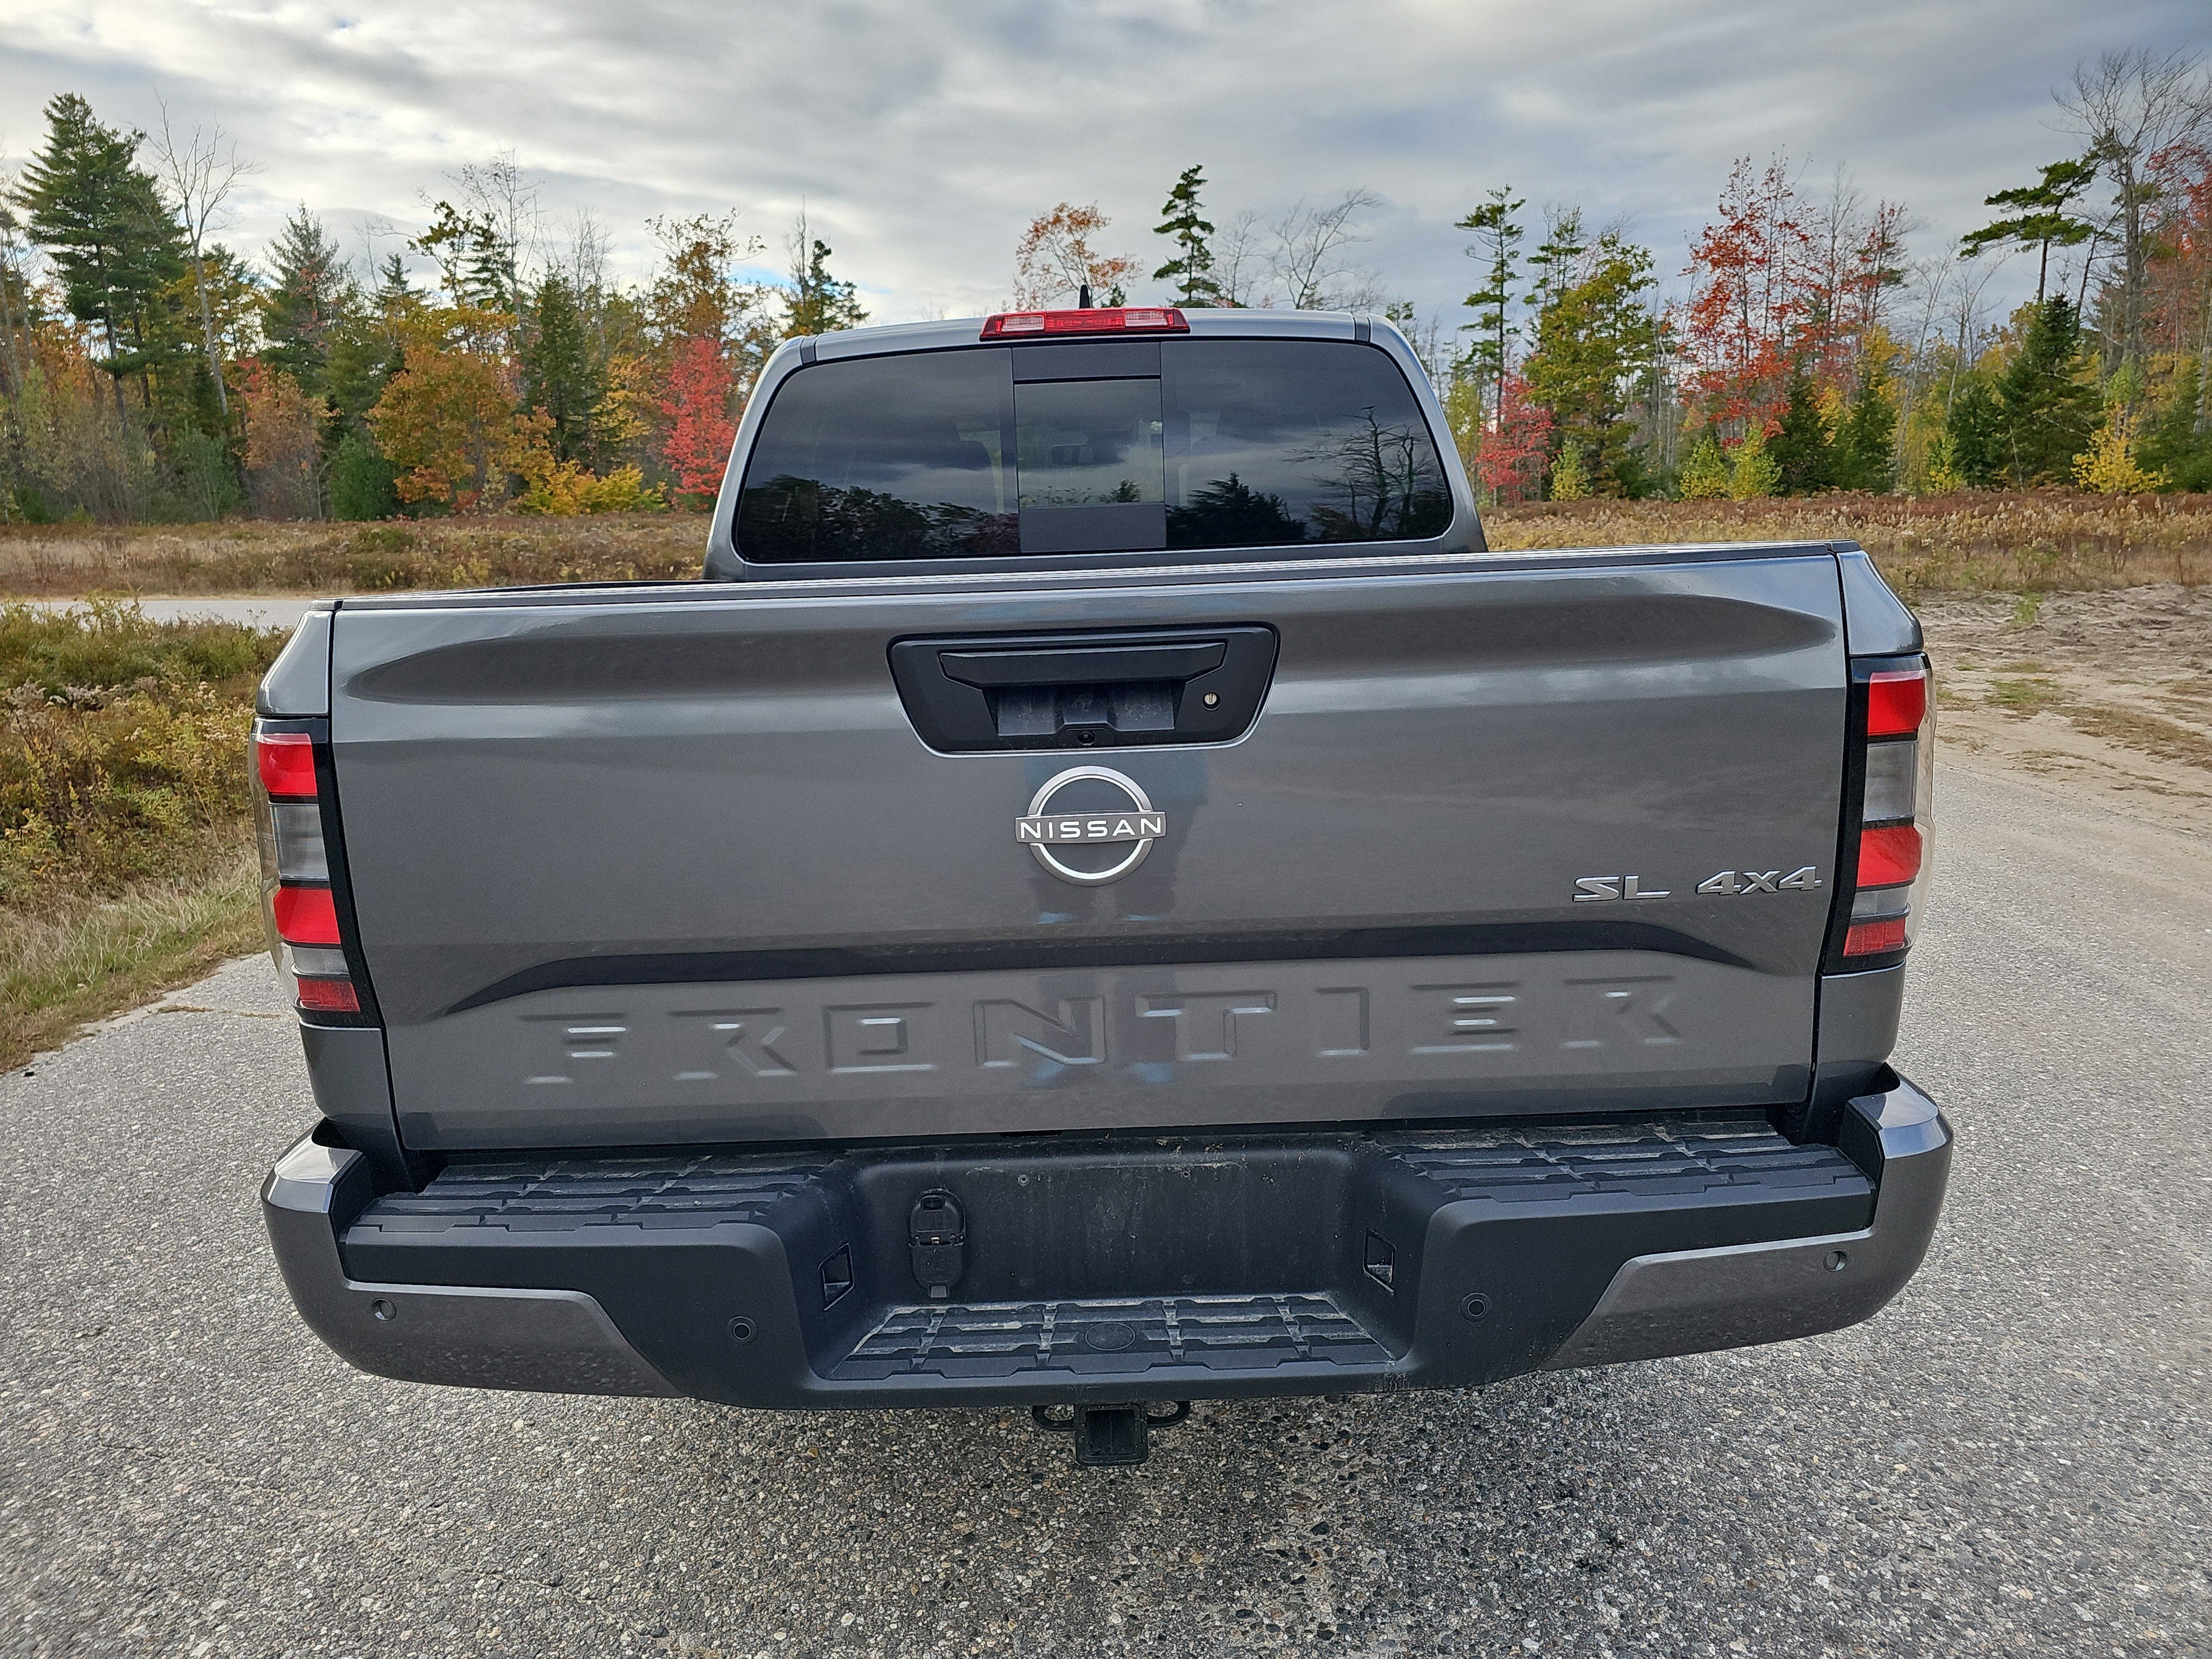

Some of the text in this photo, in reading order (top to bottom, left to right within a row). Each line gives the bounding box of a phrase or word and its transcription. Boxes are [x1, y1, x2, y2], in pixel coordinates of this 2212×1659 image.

[1020, 816, 1162, 839] NISSAN
[1572, 875, 1671, 902] SL
[519, 975, 1682, 1084] FRONTIER
